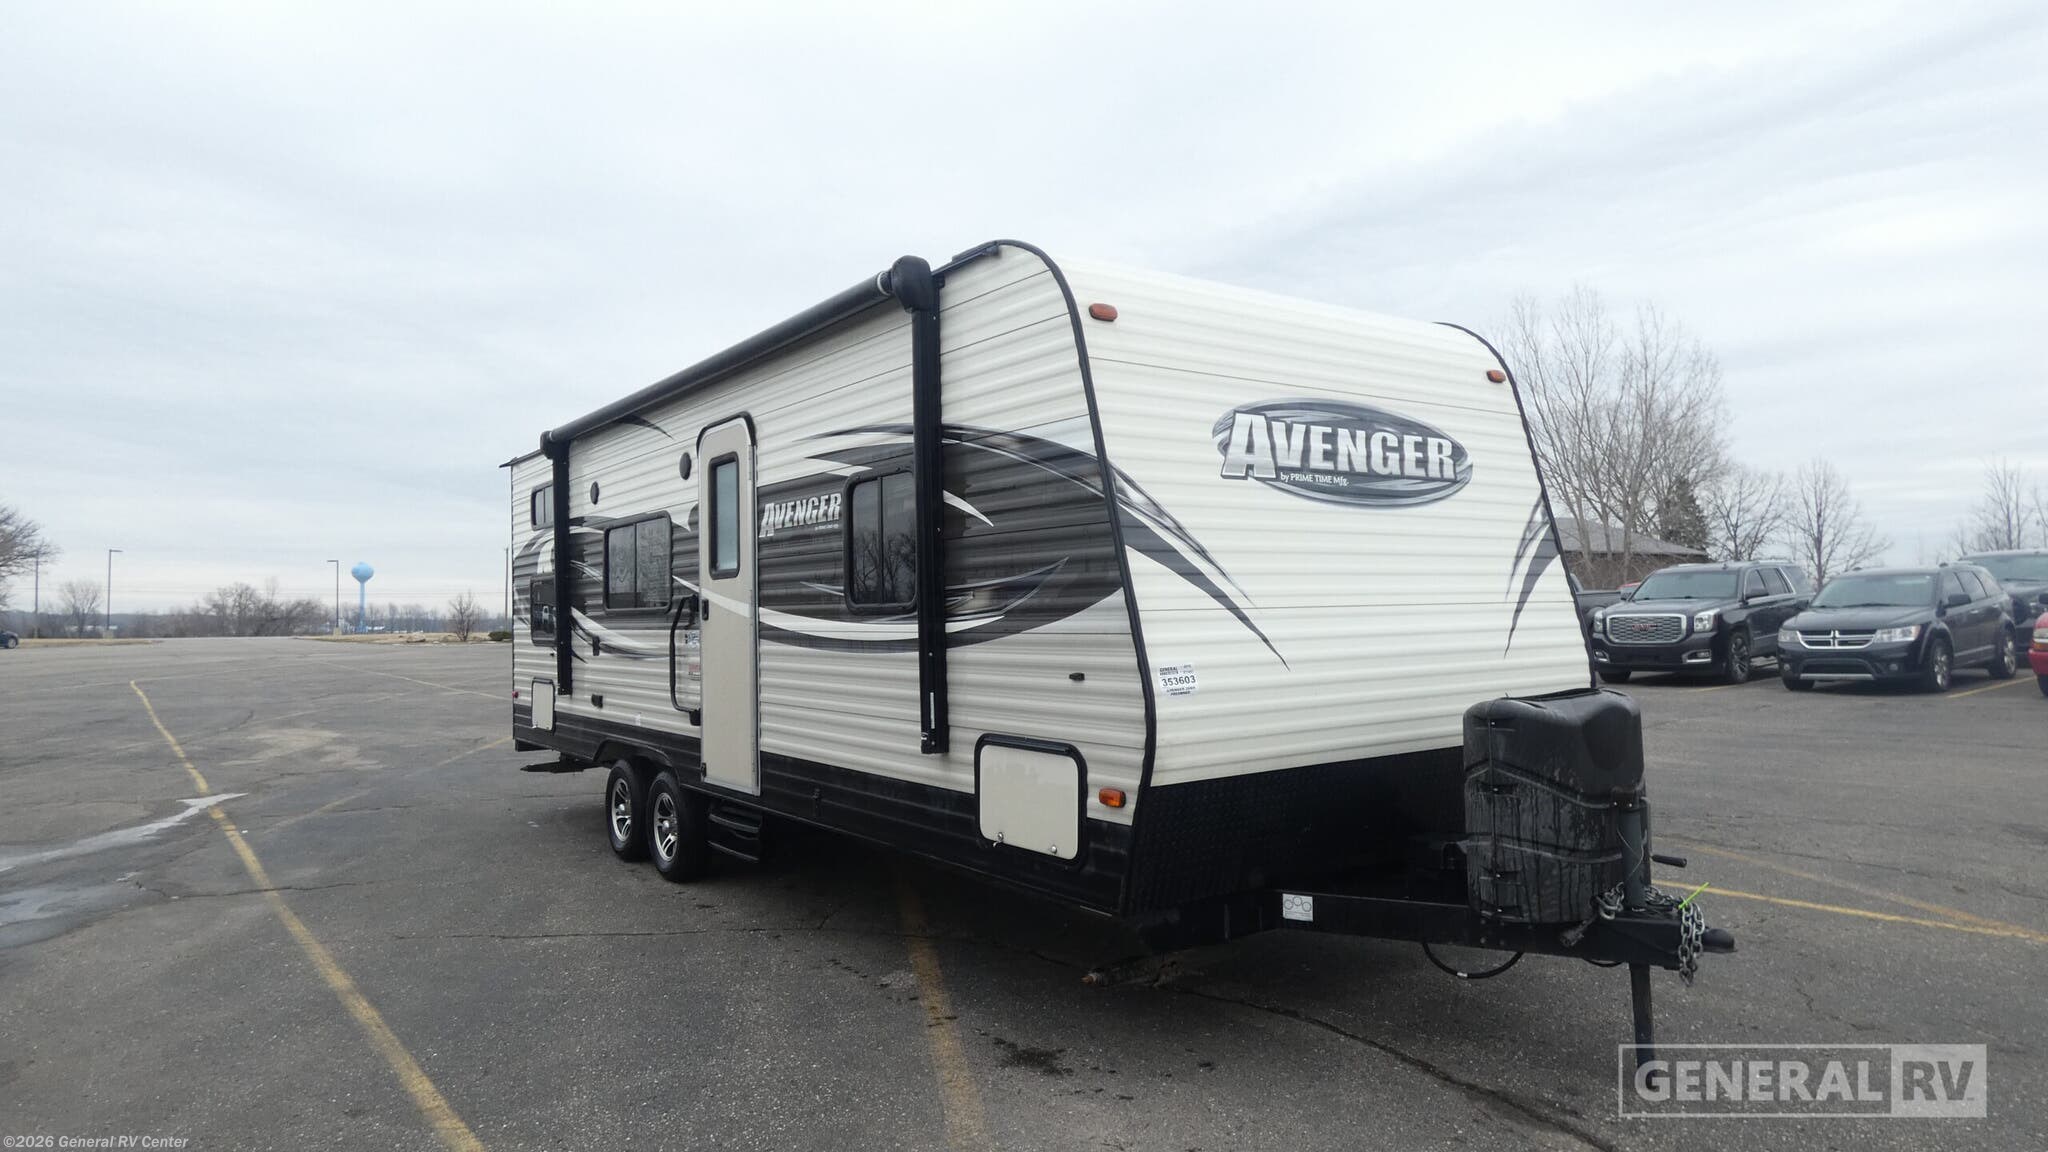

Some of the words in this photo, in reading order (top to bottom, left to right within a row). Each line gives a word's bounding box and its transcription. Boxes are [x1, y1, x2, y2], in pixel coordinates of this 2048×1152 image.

[1221, 411, 1457, 480] AVENGER
[1280, 472, 1289, 482] by
[1290, 473, 1313, 482] PRIME
[1314, 474, 1332, 483] TIME
[759, 493, 842, 538] AVENGER
[1161, 675, 1196, 687] 353603
